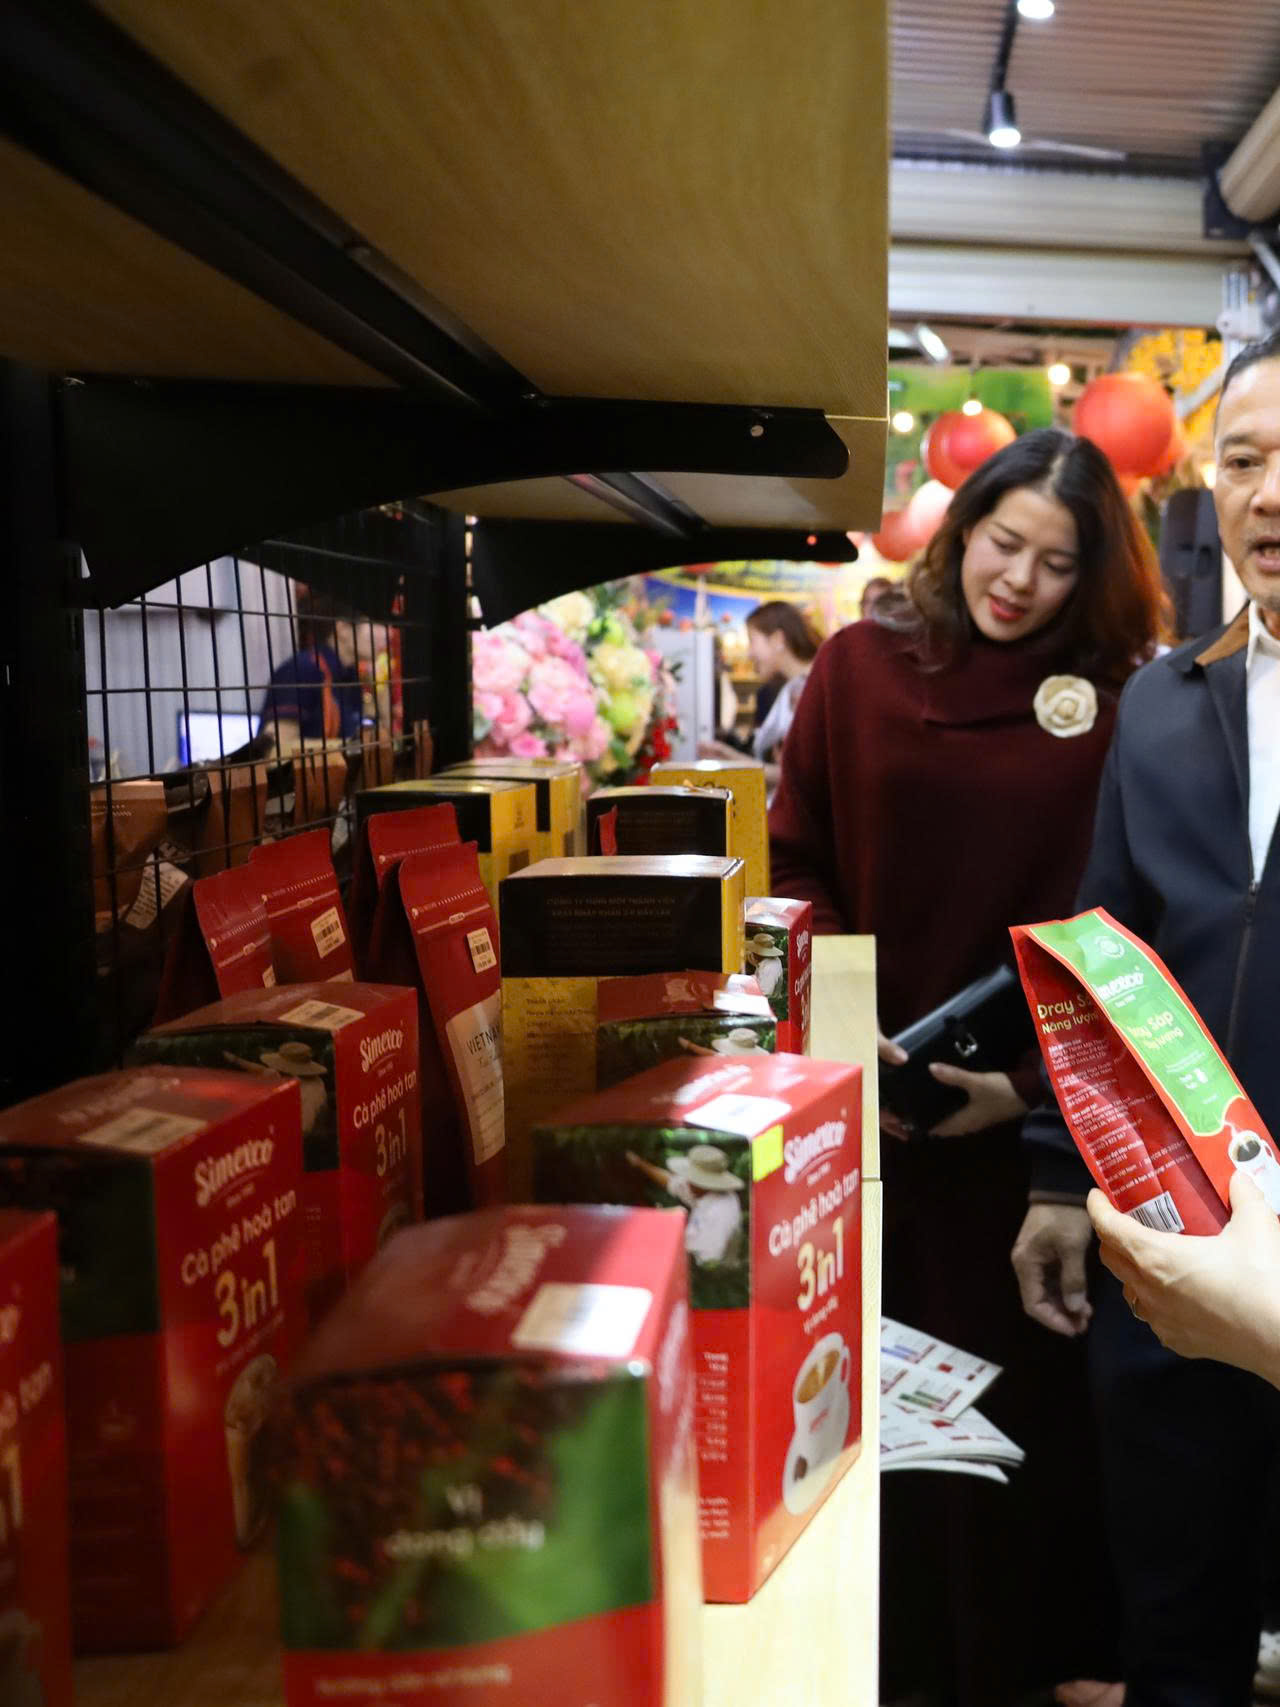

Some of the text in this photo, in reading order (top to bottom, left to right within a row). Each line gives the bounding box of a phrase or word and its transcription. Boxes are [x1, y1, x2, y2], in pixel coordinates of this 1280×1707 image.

[1037, 999, 1075, 1019] Dray
[360, 1028, 404, 1073] Simexco
[353, 1102, 369, 1129] Cà
[370, 1089, 387, 1125] phê
[387, 1076, 404, 1104] hoà
[404, 1069, 418, 1096] tan
[195, 1138, 274, 1207] Simexco
[784, 1119, 846, 1184] Simexco
[181, 1248, 209, 1286] Cà
[211, 1223, 241, 1274] phê
[243, 1203, 273, 1243] hoà
[274, 1189, 297, 1221] tan
[769, 1219, 792, 1257] Cà
[793, 1195, 818, 1247] phê
[843, 1168, 860, 1197] tan
